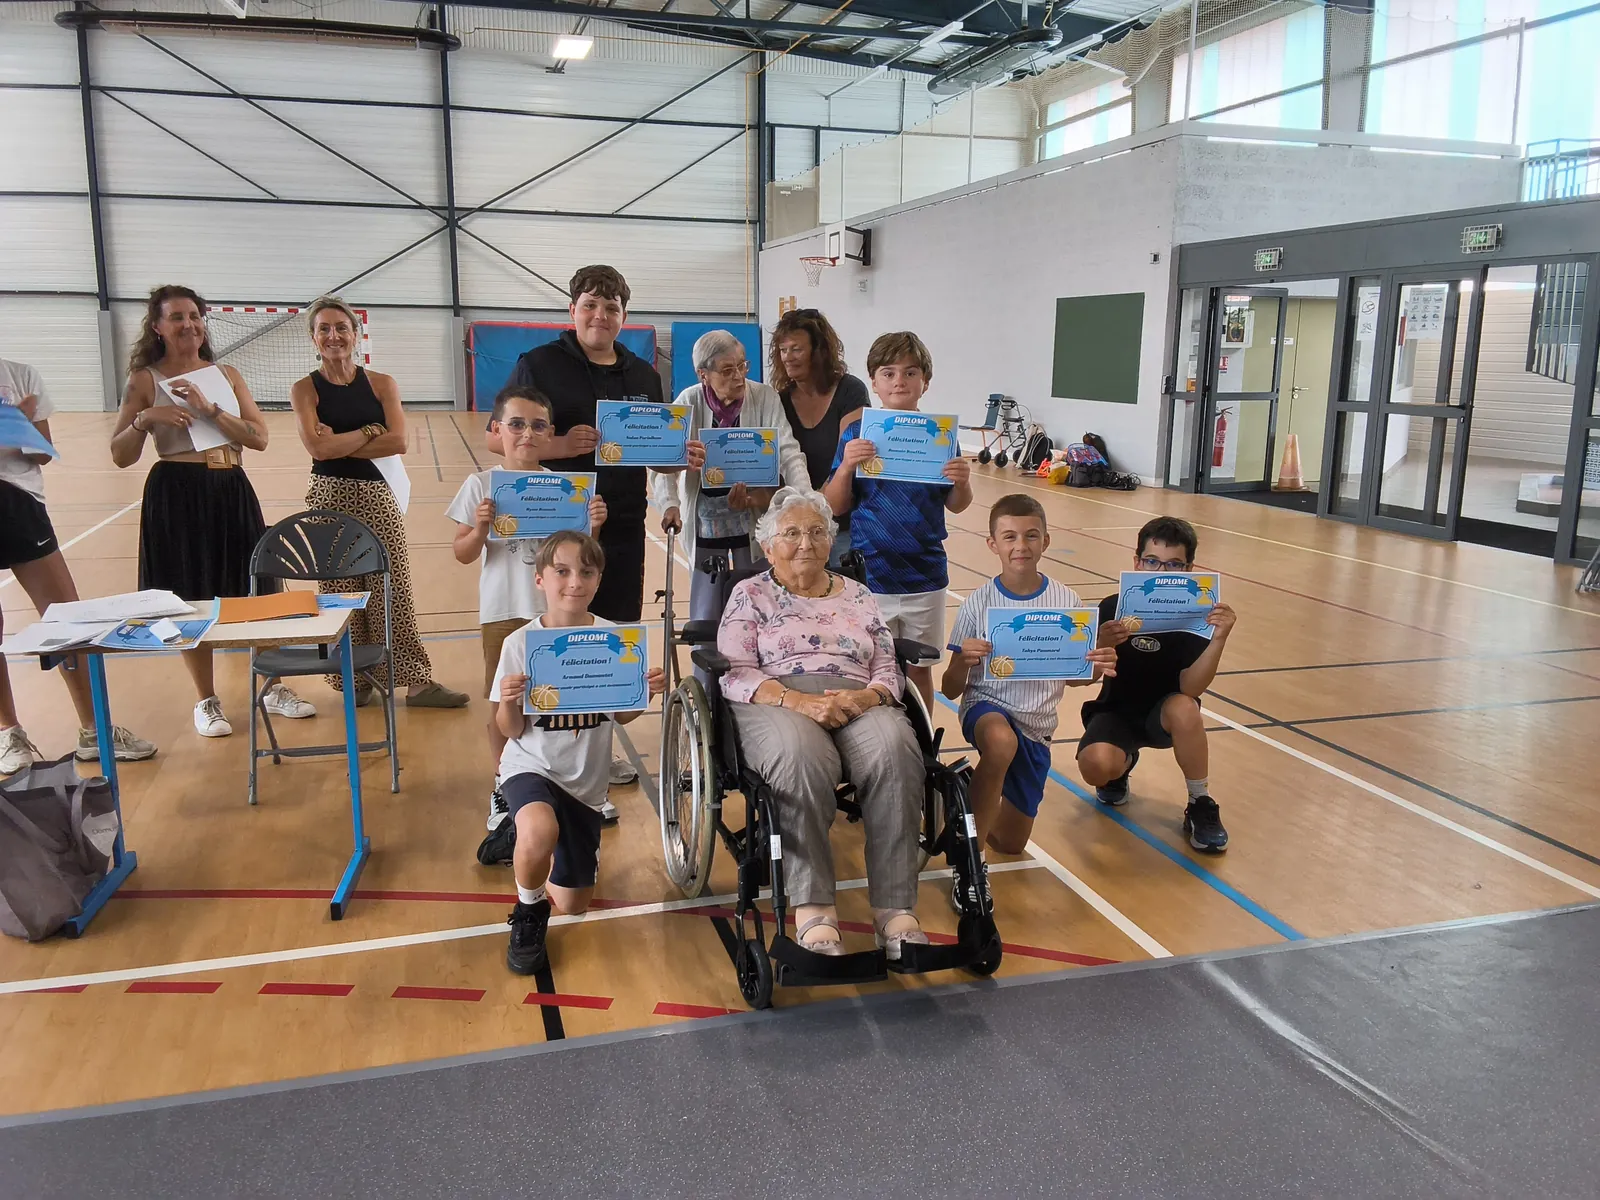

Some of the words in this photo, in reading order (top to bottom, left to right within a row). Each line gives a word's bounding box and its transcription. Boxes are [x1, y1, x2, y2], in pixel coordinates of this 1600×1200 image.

[629, 405, 663, 414] DIPLOME
[894, 416, 928, 426] DIPLOME
[727, 431, 754, 440] DIPLOME
[887, 436, 925, 444] Félicitation
[724, 448, 753, 456] Félicitation
[526, 476, 562, 485] DIPLOME
[520, 494, 559, 502] Félicitation
[1154, 577, 1189, 586] DIPLOME
[1147, 597, 1186, 605] Félicitation
[1024, 613, 1063, 622] DIPLOME
[567, 632, 610, 643] DIPLOME
[1018, 634, 1059, 642] Félicitation
[561, 658, 607, 667] Félicitation
